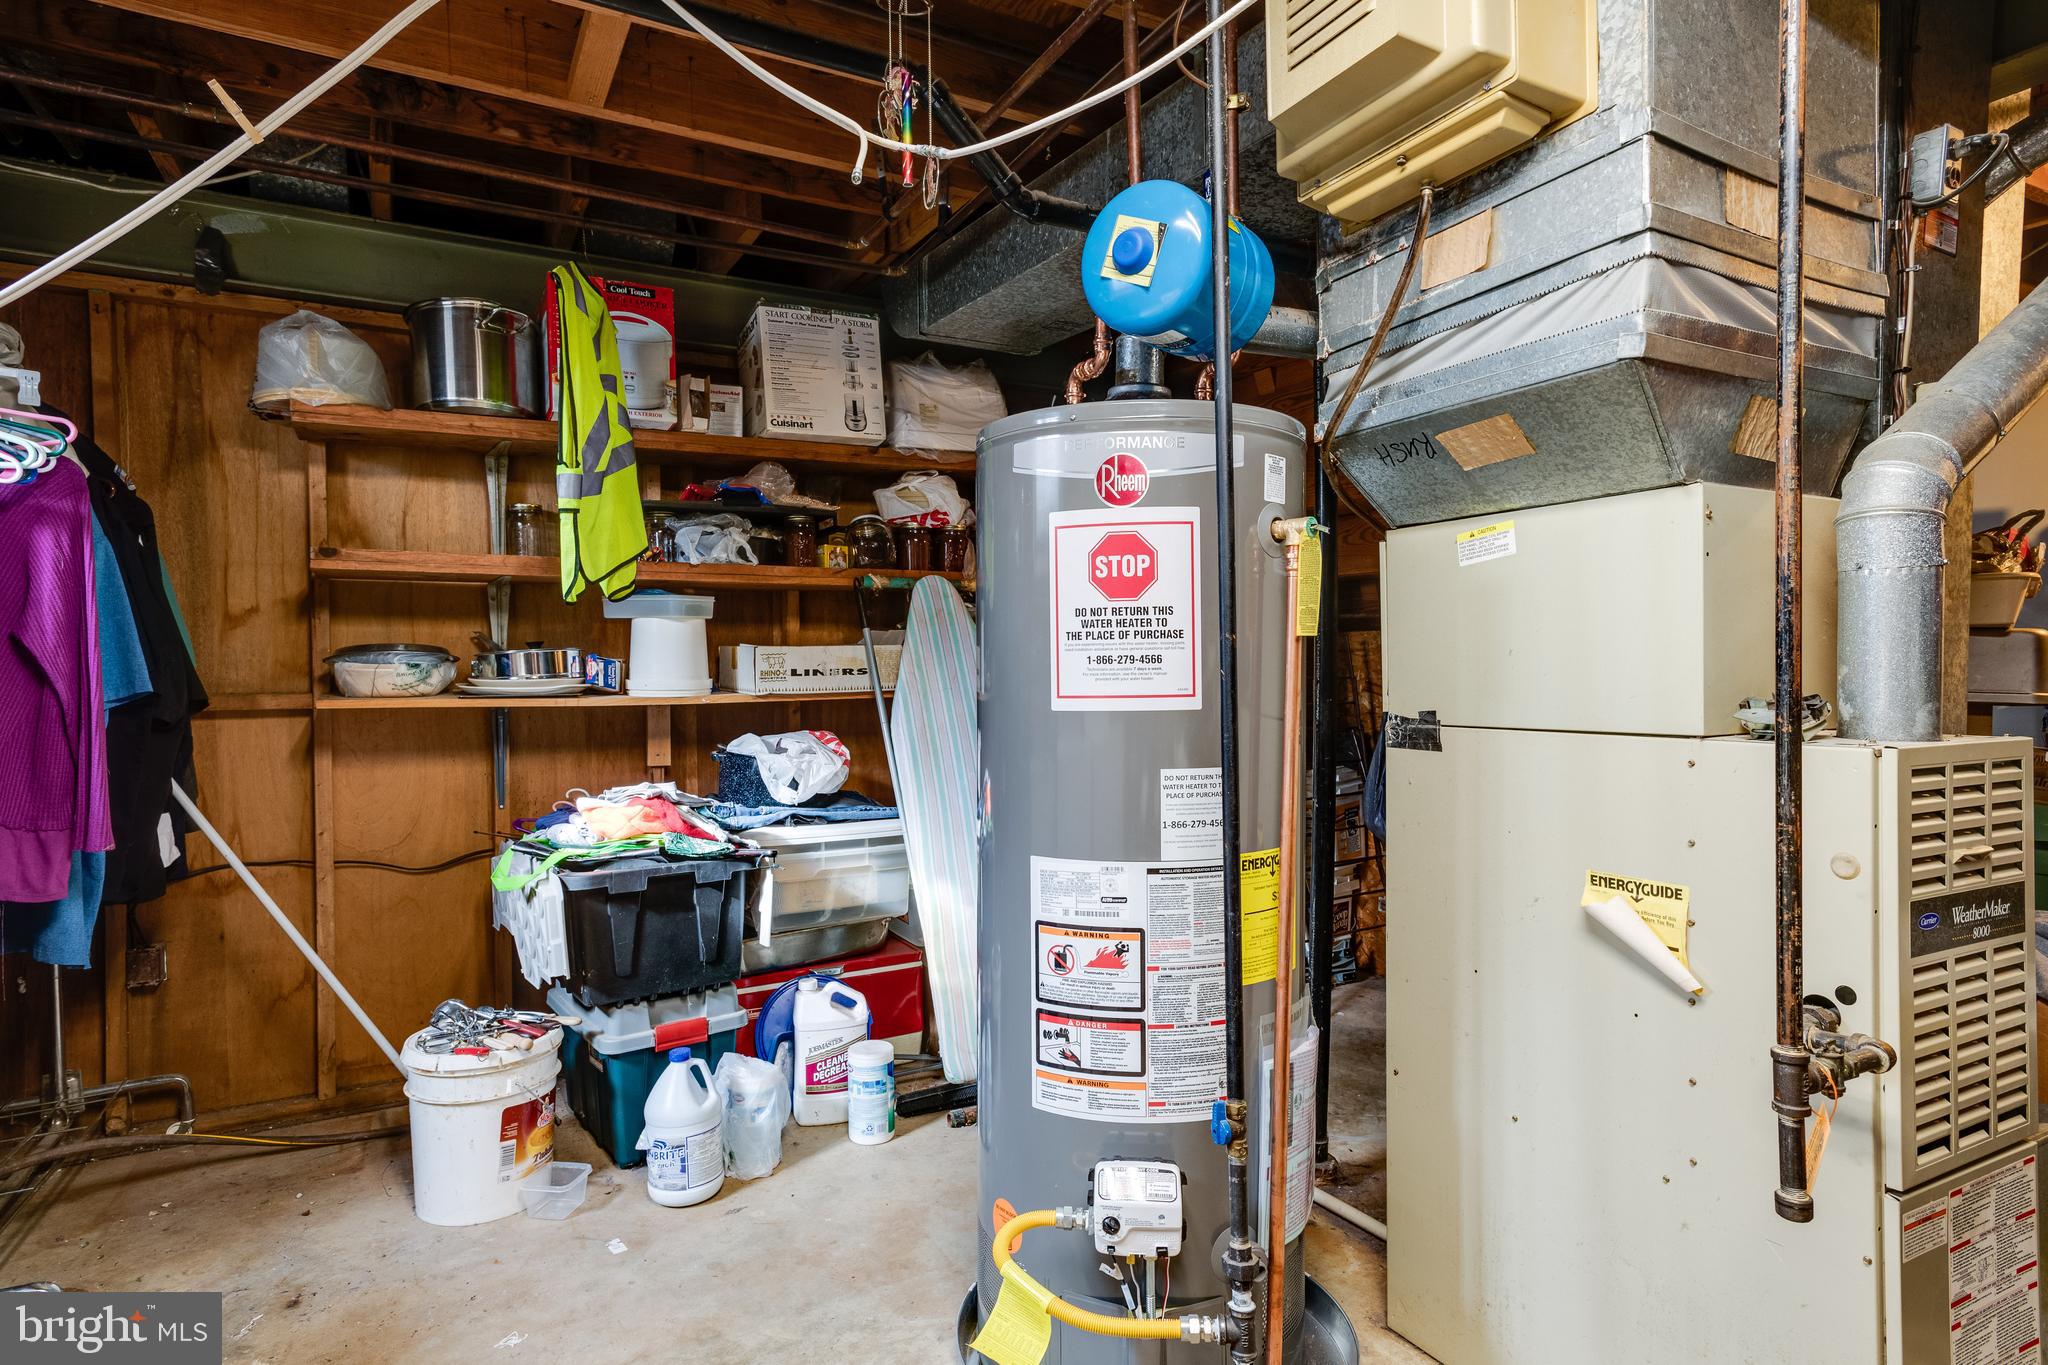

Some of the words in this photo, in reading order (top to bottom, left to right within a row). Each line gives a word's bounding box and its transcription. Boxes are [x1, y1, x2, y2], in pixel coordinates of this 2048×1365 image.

[610, 286, 628, 294] Cool
[629, 288, 651, 298] Touch
[765, 310, 789, 318] START
[790, 312, 828, 324] COOKING
[829, 315, 840, 324] UP
[848, 320, 872, 329] STORM
[770, 418, 814, 429] Cuisinart
[1101, 456, 1146, 499] Rheem
[1478, 526, 1496, 534] CAUTION
[1096, 554, 1150, 578] STOP
[1075, 608, 1086, 617] DO
[1090, 607, 1108, 617] NOT
[1112, 606, 1149, 616] RETURN
[1152, 606, 1174, 615] THIS
[1080, 619, 1112, 628] WATER
[1116, 618, 1152, 628] HEATER
[1155, 618, 1167, 627] TO
[1066, 632, 1082, 641] THE
[1086, 631, 1115, 640] PLACE
[1118, 630, 1130, 640] OF
[1134, 630, 1184, 639] PURCHASE
[1087, 655, 1162, 664] 1-866-279-4566
[790, 668, 869, 677] LINERS
[1163, 819, 1223, 829] 1-866-279-456
[1590, 874, 1683, 900] ENERGYGUIDE
[1952, 899, 2010, 924] WeatherMaker
[1920, 917, 1938, 927] Carrier
[1073, 930, 1110, 939] WARNING
[1973, 924, 1990, 939] 8000
[1075, 1020, 1107, 1029] DANGER
[808, 1036, 844, 1056] JOBMASTER
[816, 1052, 849, 1072] CLEANE
[813, 1062, 849, 1082] DEGREA
[1077, 1079, 1109, 1088] WARNING
